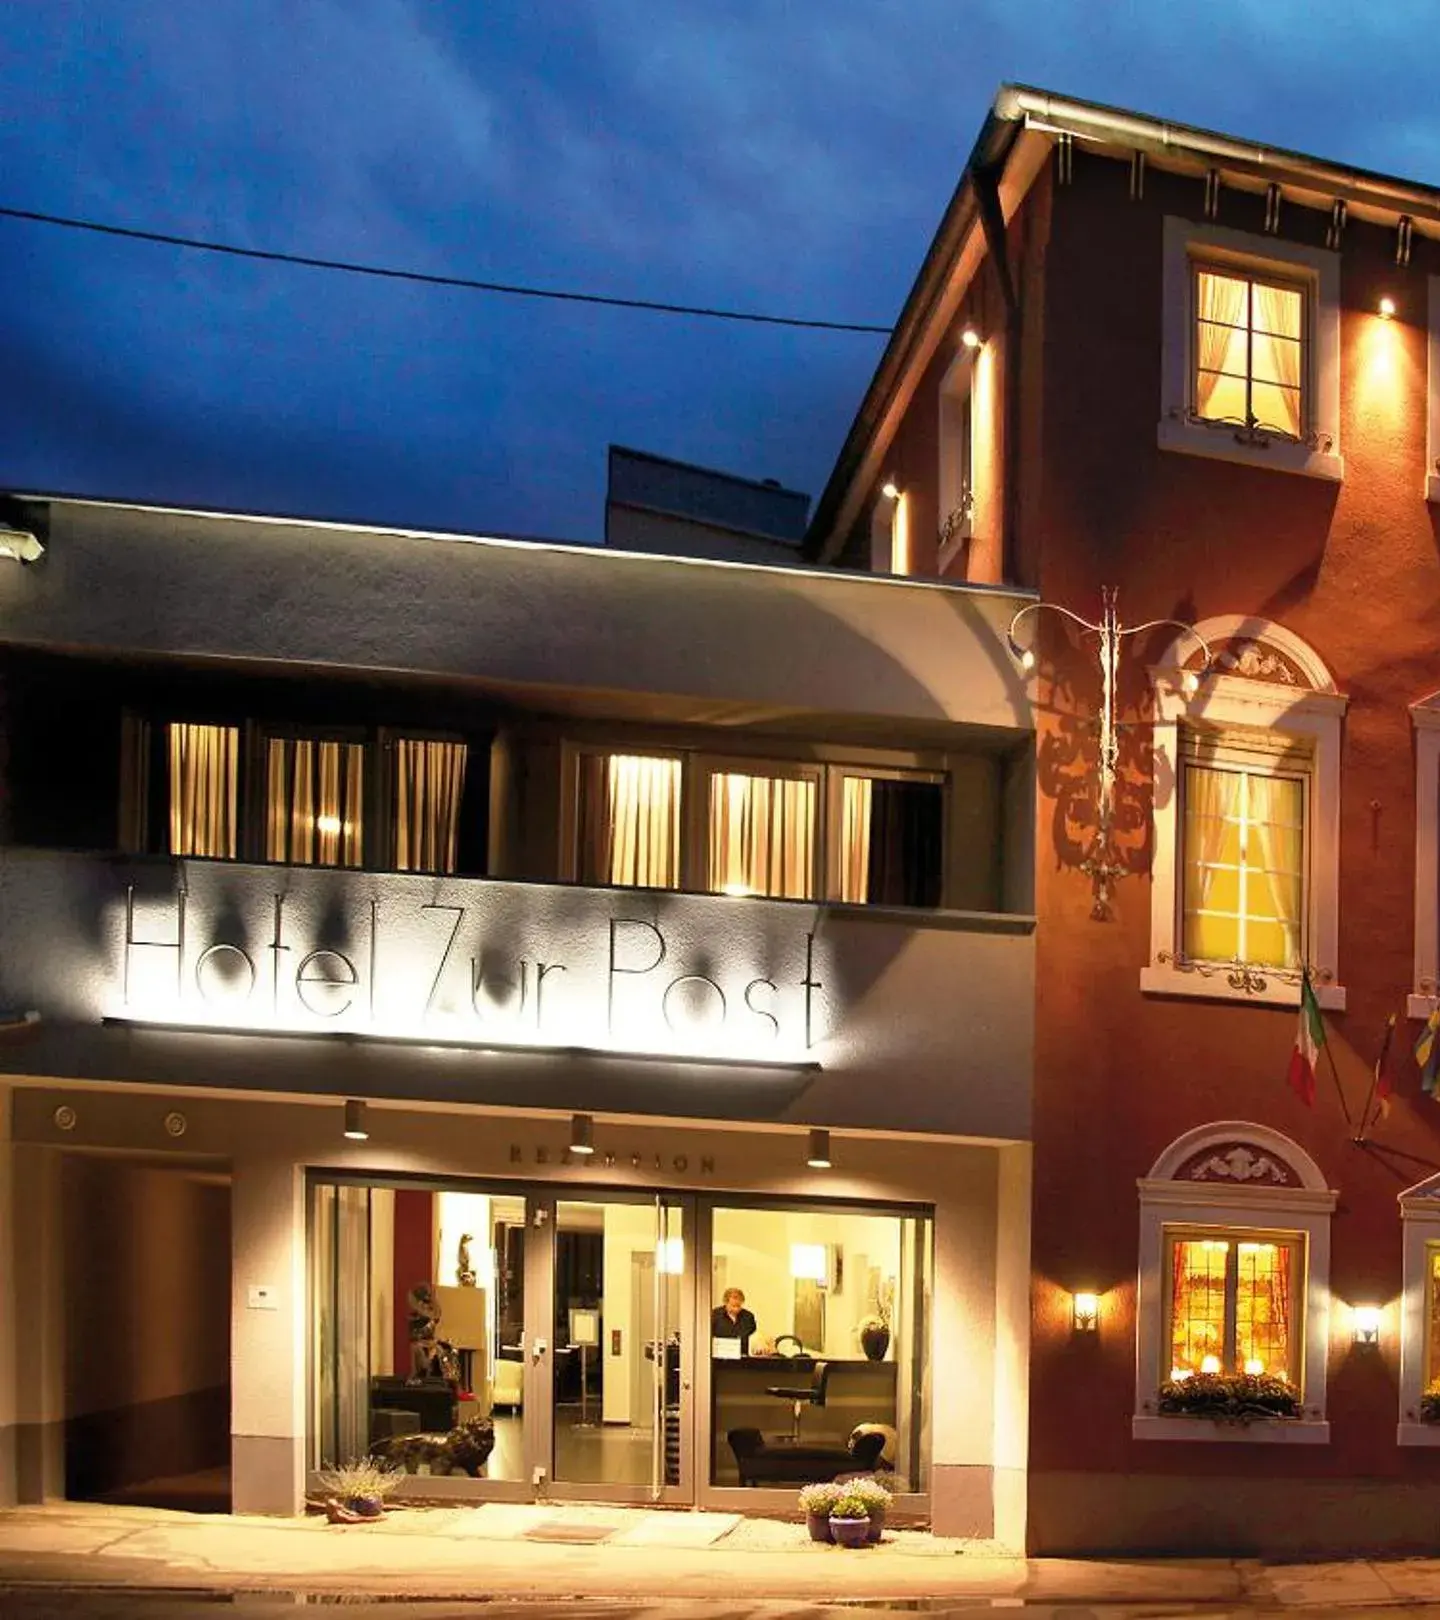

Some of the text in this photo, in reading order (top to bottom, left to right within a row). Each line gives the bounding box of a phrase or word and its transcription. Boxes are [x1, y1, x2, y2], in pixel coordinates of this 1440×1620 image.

[122, 885, 823, 1050] Hotel Zur Post
